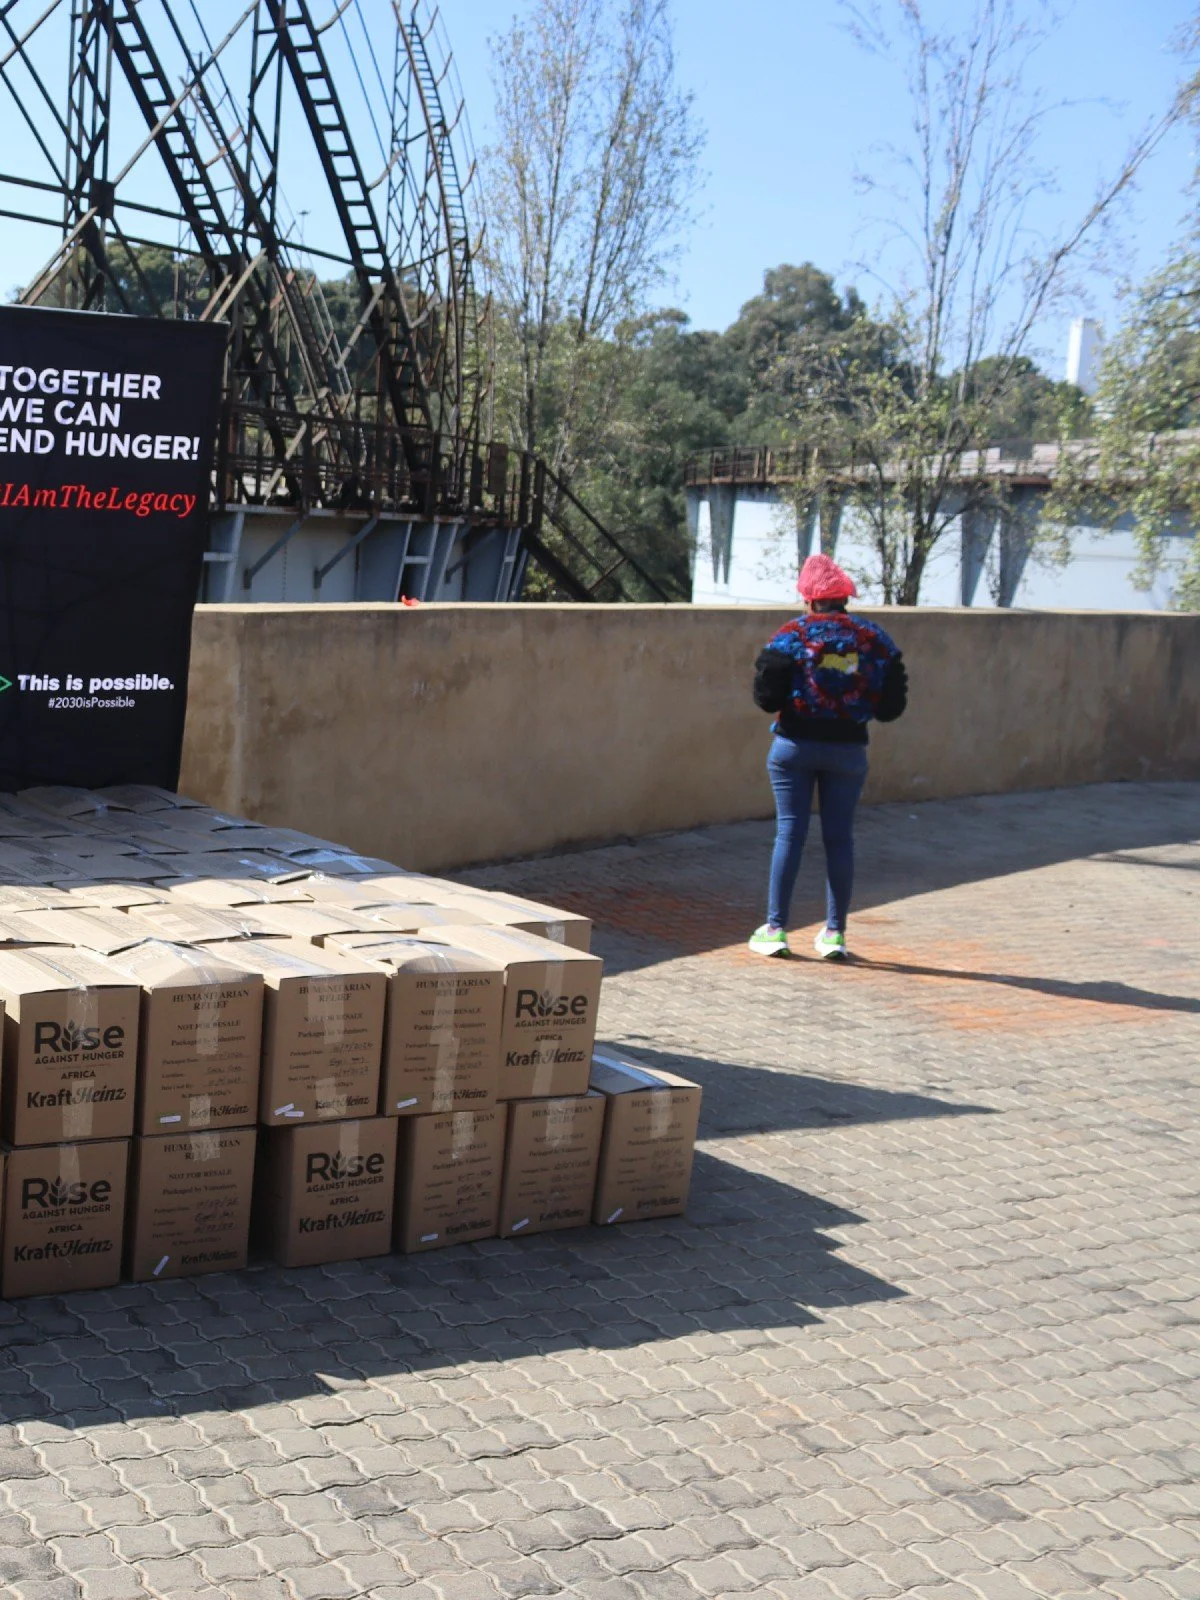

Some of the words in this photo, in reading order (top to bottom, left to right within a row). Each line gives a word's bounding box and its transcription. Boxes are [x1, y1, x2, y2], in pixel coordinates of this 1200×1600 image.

[54, 400, 121, 428] CAN
[65, 430, 200, 461] HUNGER!
[17, 674, 60, 691] This
[66, 674, 83, 691] is
[89, 673, 175, 694] possible.
[48, 696, 136, 709] #2030isPossible
[298, 983, 371, 994] HUMANITARIAN
[415, 978, 491, 989] HUMANITARIAN
[514, 1019, 551, 1028] AGAINST
[171, 1038, 200, 1046] Packag
[35, 1054, 79, 1064] AGAINST
[82, 1051, 125, 1062] HUNGER
[61, 1070, 96, 1080] AFRICA
[434, 1113, 496, 1130] HUMARIAN
[163, 1139, 241, 1152] HUMANARIAN
[306, 1181, 345, 1193] AGAINST
[348, 1176, 384, 1188] HUNGER
[329, 1195, 360, 1206] AFRICA
[22, 1208, 66, 1220] AGAINST
[69, 1204, 111, 1215] HUNGER
[47, 1224, 83, 1234] AFRICA
